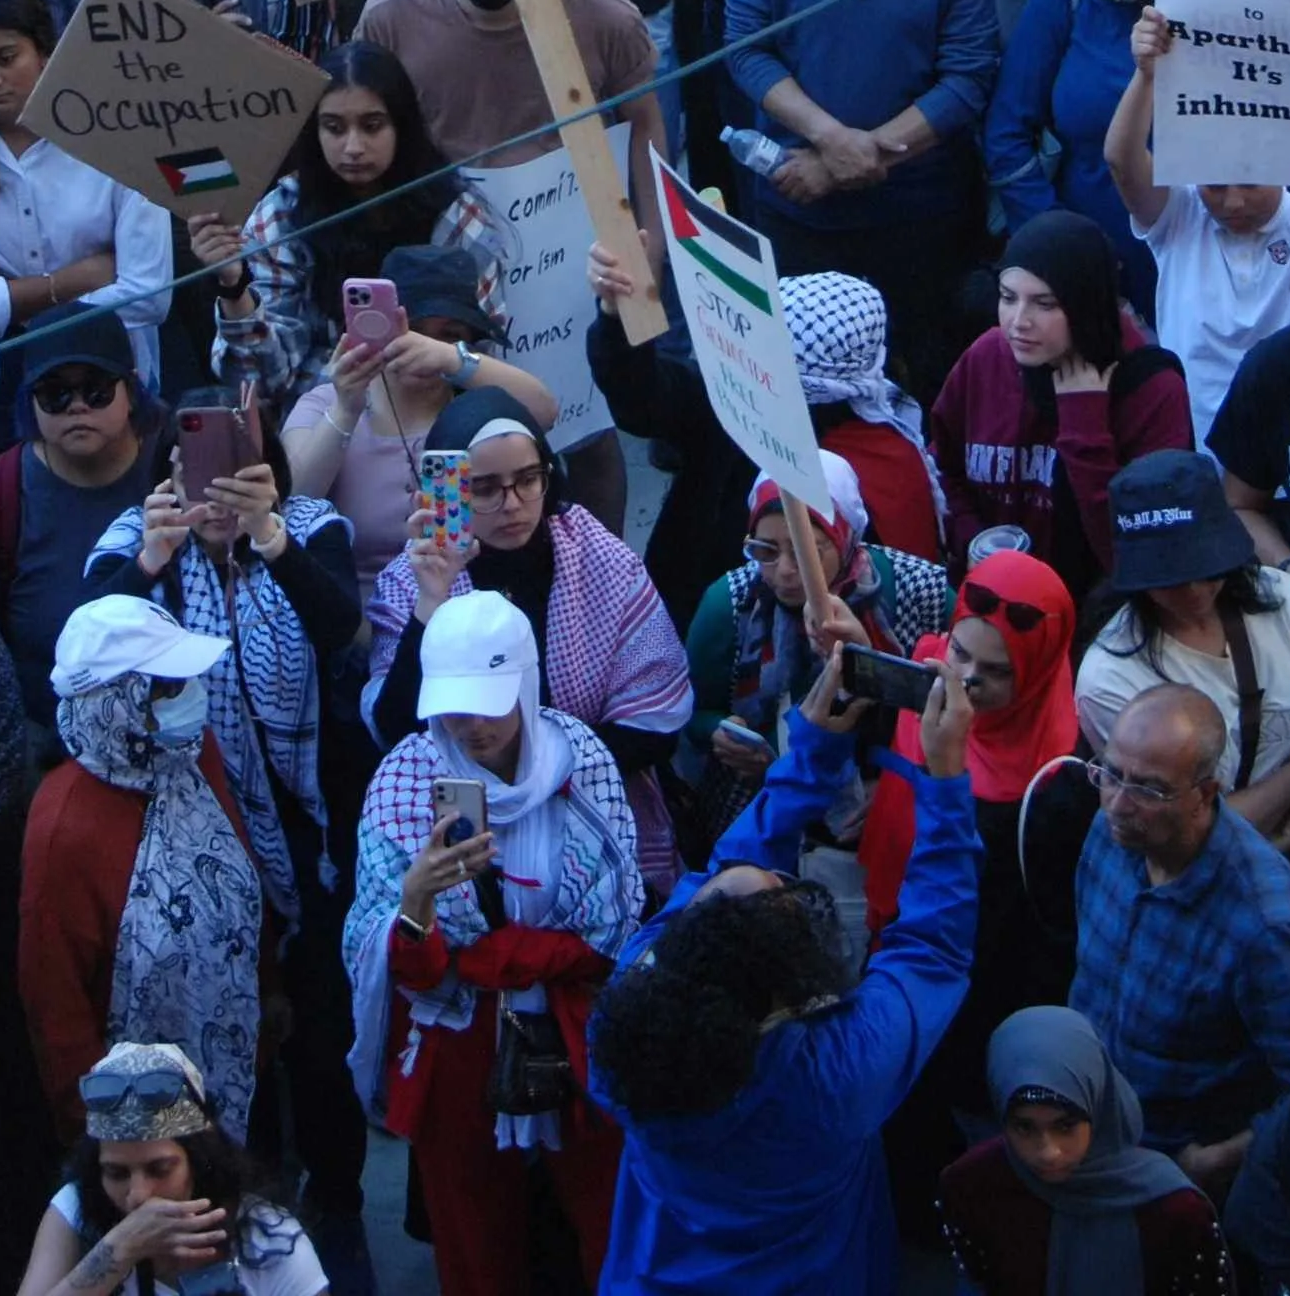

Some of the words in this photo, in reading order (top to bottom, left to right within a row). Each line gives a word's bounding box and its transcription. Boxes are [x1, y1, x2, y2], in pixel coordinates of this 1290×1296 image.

[86, 0, 187, 44] END
[1244, 7, 1263, 20] to
[114, 51, 185, 83] the
[1233, 61, 1283, 85] It's
[52, 87, 298, 147] Occupation
[695, 271, 751, 339] STOP
